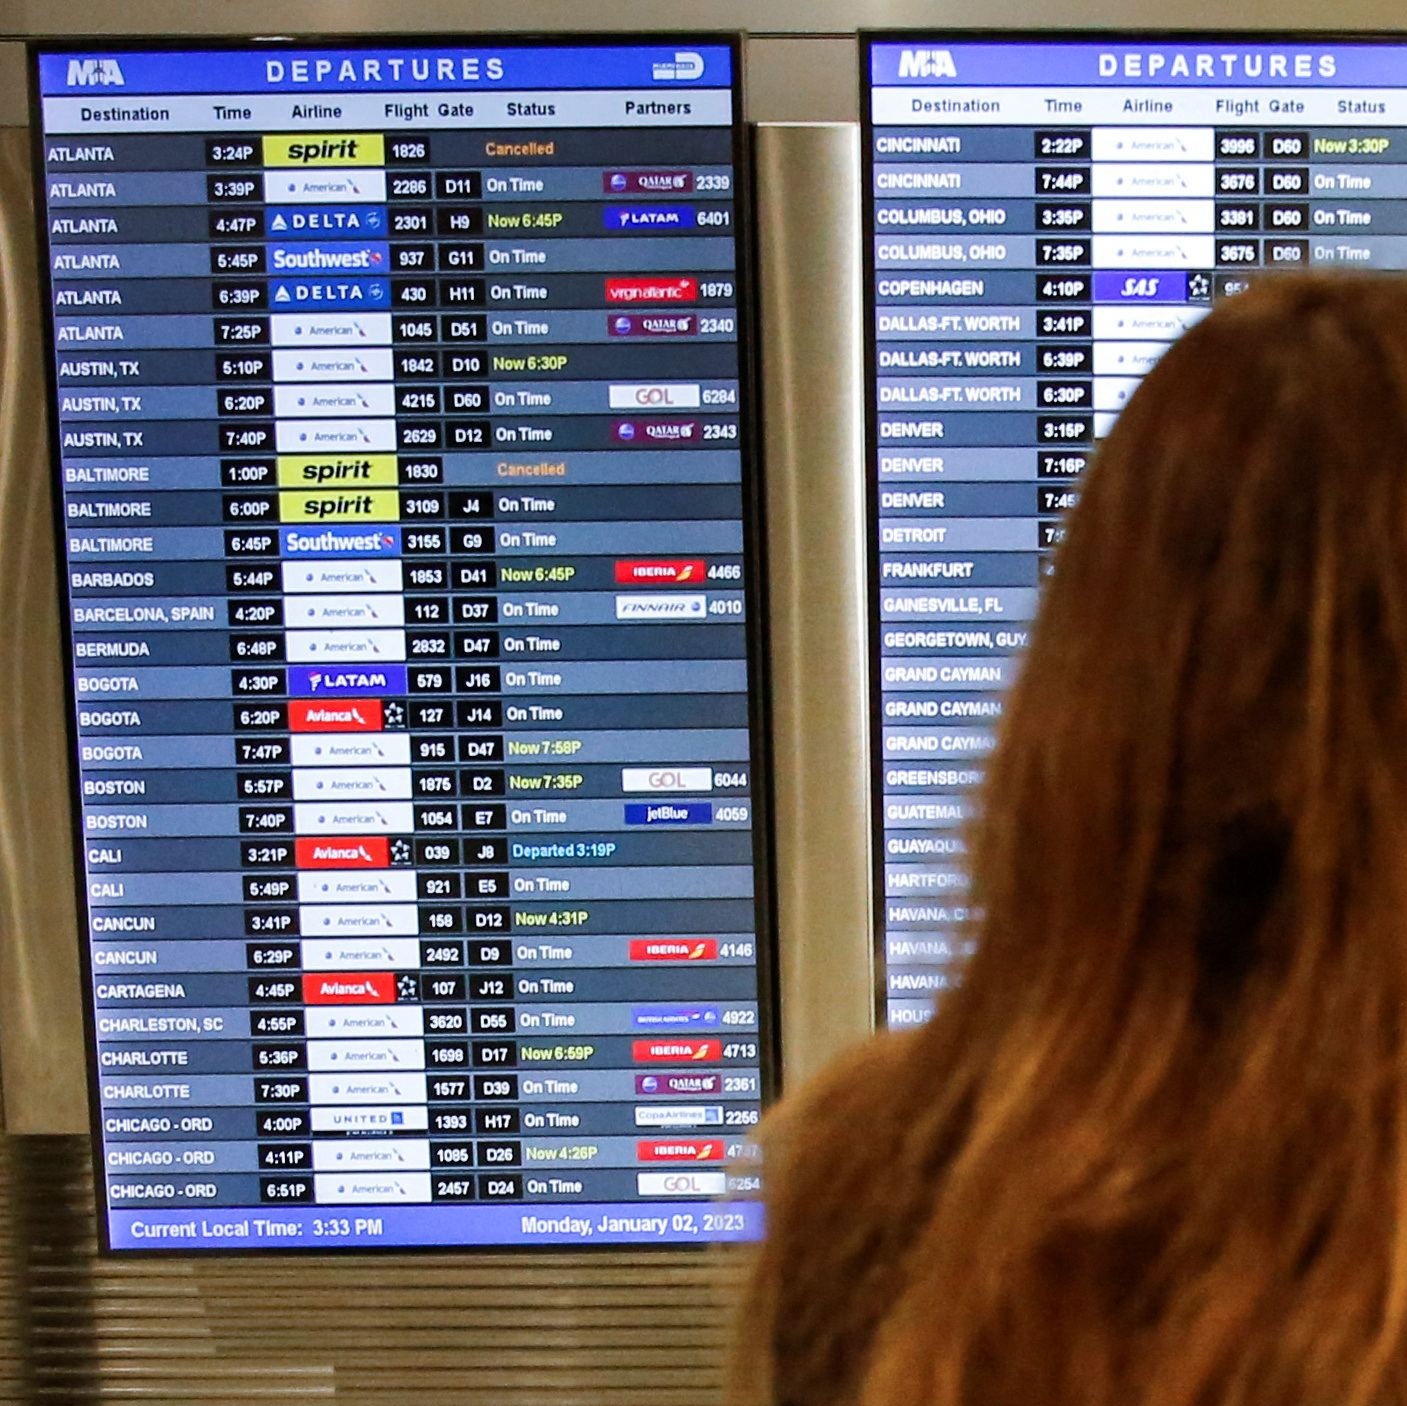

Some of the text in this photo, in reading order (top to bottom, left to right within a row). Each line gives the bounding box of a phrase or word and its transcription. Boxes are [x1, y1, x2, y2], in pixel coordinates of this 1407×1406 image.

[267, 58, 503, 82] DEPARTURES
[1100, 54, 1336, 77] DEPARTURES
[82, 101, 691, 121] Destination Time Airline Flight Gate Status Partners
[912, 99, 999, 112] Destination
[1045, 99, 1082, 112] Time
[1124, 100, 1172, 112] Airline
[1216, 100, 1258, 116] Flight
[1270, 100, 1304, 112] Gate
[1338, 100, 1385, 113] Status
[48, 140, 553, 163] ATLANTA 3:24P spirit 1826 Cancelled
[877, 138, 1389, 153] CINCINNATI 2:22P 3996 D60 Now 3:30P
[52, 212, 729, 233] ATLANTA 4:47P DELTA 2301 H9 Now 6:45P LATAM 6401
[879, 279, 1158, 296] COPENHAGEN 4:10P SAS
[883, 528, 946, 542] DETROIT
[883, 563, 973, 577] FRANKFURT
[74, 608, 168, 622] BARCELONA,
[171, 607, 213, 620] SPAIN
[236, 607, 275, 620] 4:20P
[415, 605, 439, 618] 112
[463, 604, 488, 617] D37
[503, 603, 523, 616] On
[525, 603, 558, 616] Time
[709, 600, 741, 614] 4010
[885, 667, 1000, 681] GRAND CAYMAN
[80, 712, 140, 726] BOGOTA
[241, 711, 280, 724] 6:20P
[420, 709, 443, 722] 127
[467, 708, 491, 722] J14
[507, 707, 527, 720] On
[529, 706, 562, 720] Time
[88, 849, 121, 863] CALI
[249, 848, 287, 861] 3:21P
[425, 846, 450, 859] 039
[478, 846, 494, 859] J8
[513, 844, 574, 859] Departed
[577, 843, 615, 856] 3:19P
[131, 1215, 744, 1237] Current Local Time: 3:33 PM Monday, January 02, 2023
